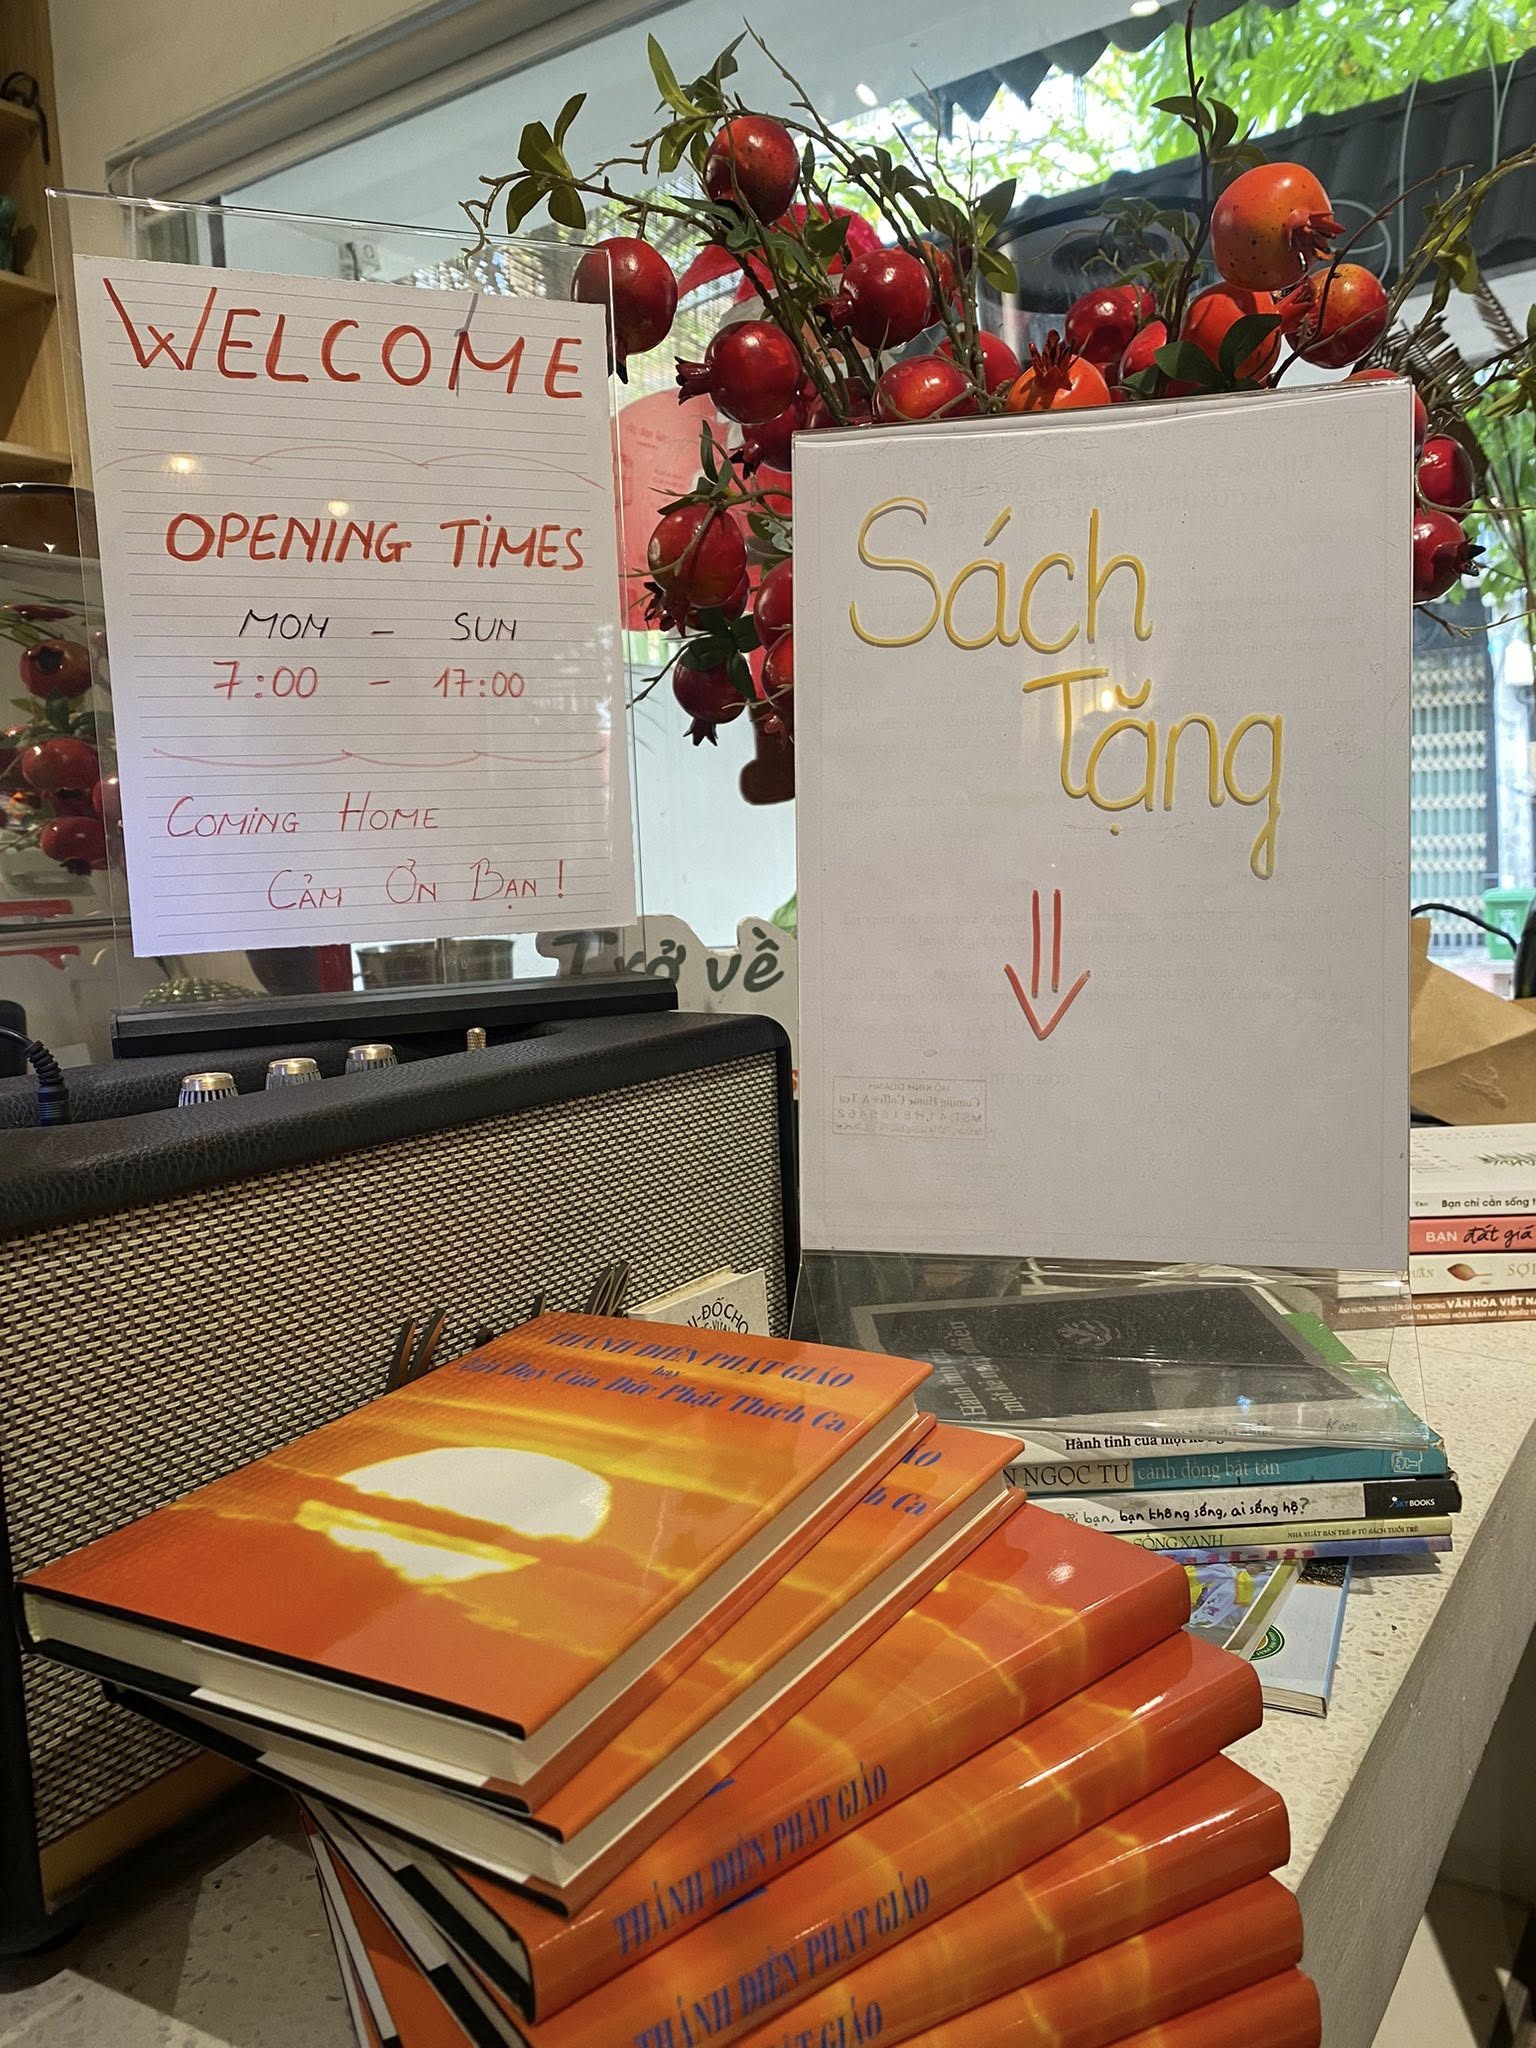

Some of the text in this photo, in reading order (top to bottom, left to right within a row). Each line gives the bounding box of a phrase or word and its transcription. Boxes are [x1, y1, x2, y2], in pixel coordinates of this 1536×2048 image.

[103, 276, 583, 400] WELCOME
[165, 511, 412, 565] OPENING
[849, 495, 1154, 654] Sách
[238, 609, 331, 641] MON
[450, 611, 518, 643] SUN
[212, 659, 319, 700] 7:00
[432, 666, 526, 700] 17:00
[1022, 666, 1286, 880] Tặng
[706, 926, 785, 993] về
[1441, 1199, 1461, 1210] Bạn
[1505, 1195, 1530, 1208] sống
[1425, 1230, 1458, 1244] BẠN
[1503, 1224, 1535, 1248] giá
[1446, 1297, 1471, 1309] VĂN
[1499, 1295, 1524, 1307] VIỆT
[780, 1363, 856, 1389] GIÁO
[728, 1393, 807, 1424] Thích
[811, 1410, 847, 1434] Ca
[1064, 1436, 1102, 1450] Hành
[1104, 1435, 1132, 1448] tinh
[1023, 1463, 1092, 1487] NGỌC
[1096, 1461, 1131, 1485] TƯ
[1119, 1509, 1145, 1525] bạn
[1148, 1507, 1190, 1522] không
[1194, 1501, 1227, 1519] sống,
[1231, 1501, 1246, 1517] ai
[1249, 1498, 1279, 1517] sống
[1179, 1533, 1224, 1549] XANH
[836, 1761, 889, 1822] GIÁO
[874, 1870, 931, 1936] GIÁO
